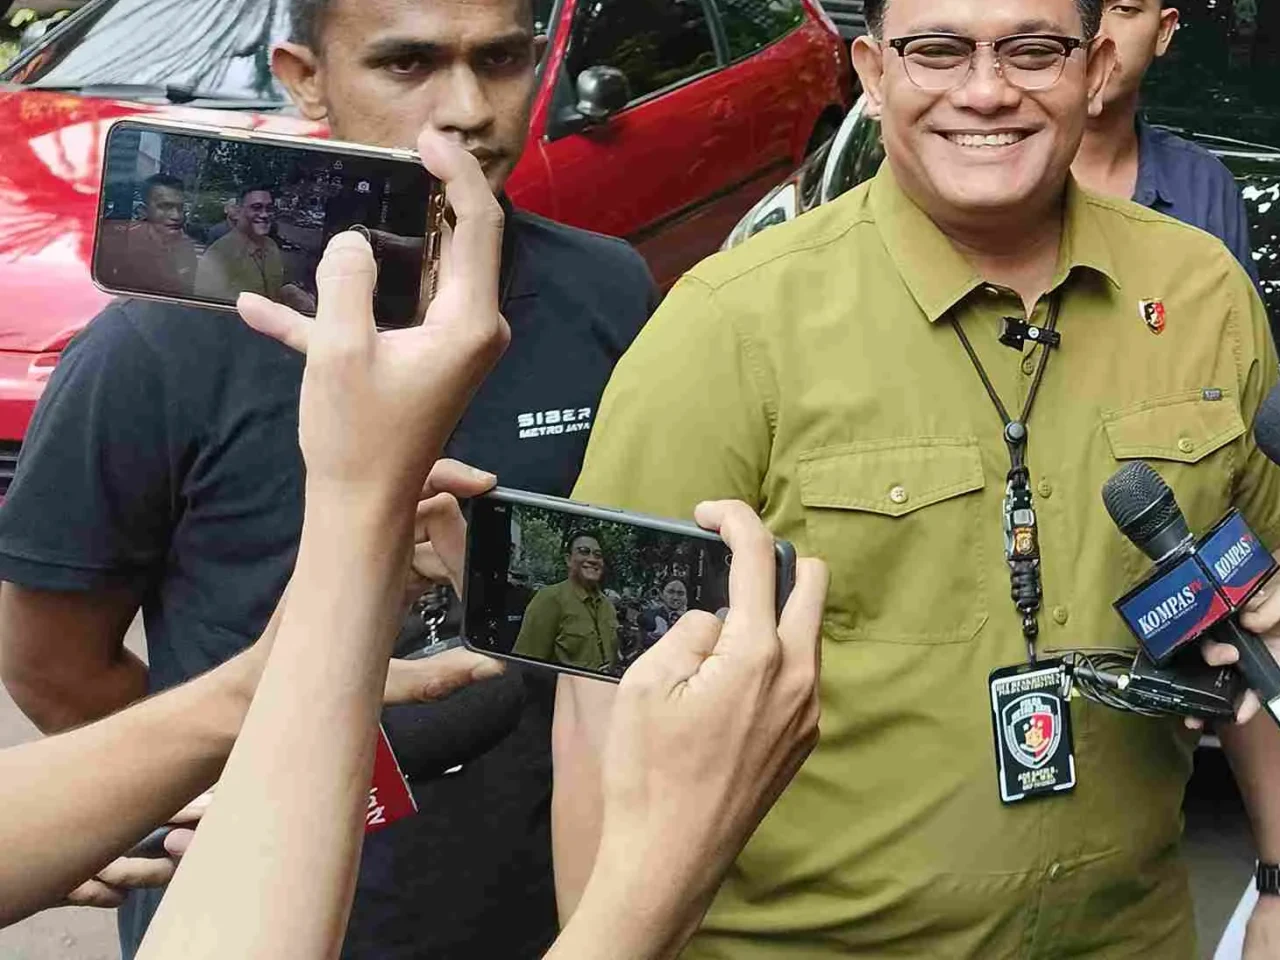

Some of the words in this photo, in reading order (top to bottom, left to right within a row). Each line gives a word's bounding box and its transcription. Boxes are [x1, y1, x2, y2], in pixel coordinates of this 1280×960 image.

[517, 407, 591, 428] SIBER
[519, 424, 564, 439] METRO
[1213, 536, 1252, 581] KOMPAS
[1137, 586, 1196, 635] KOMPAS
